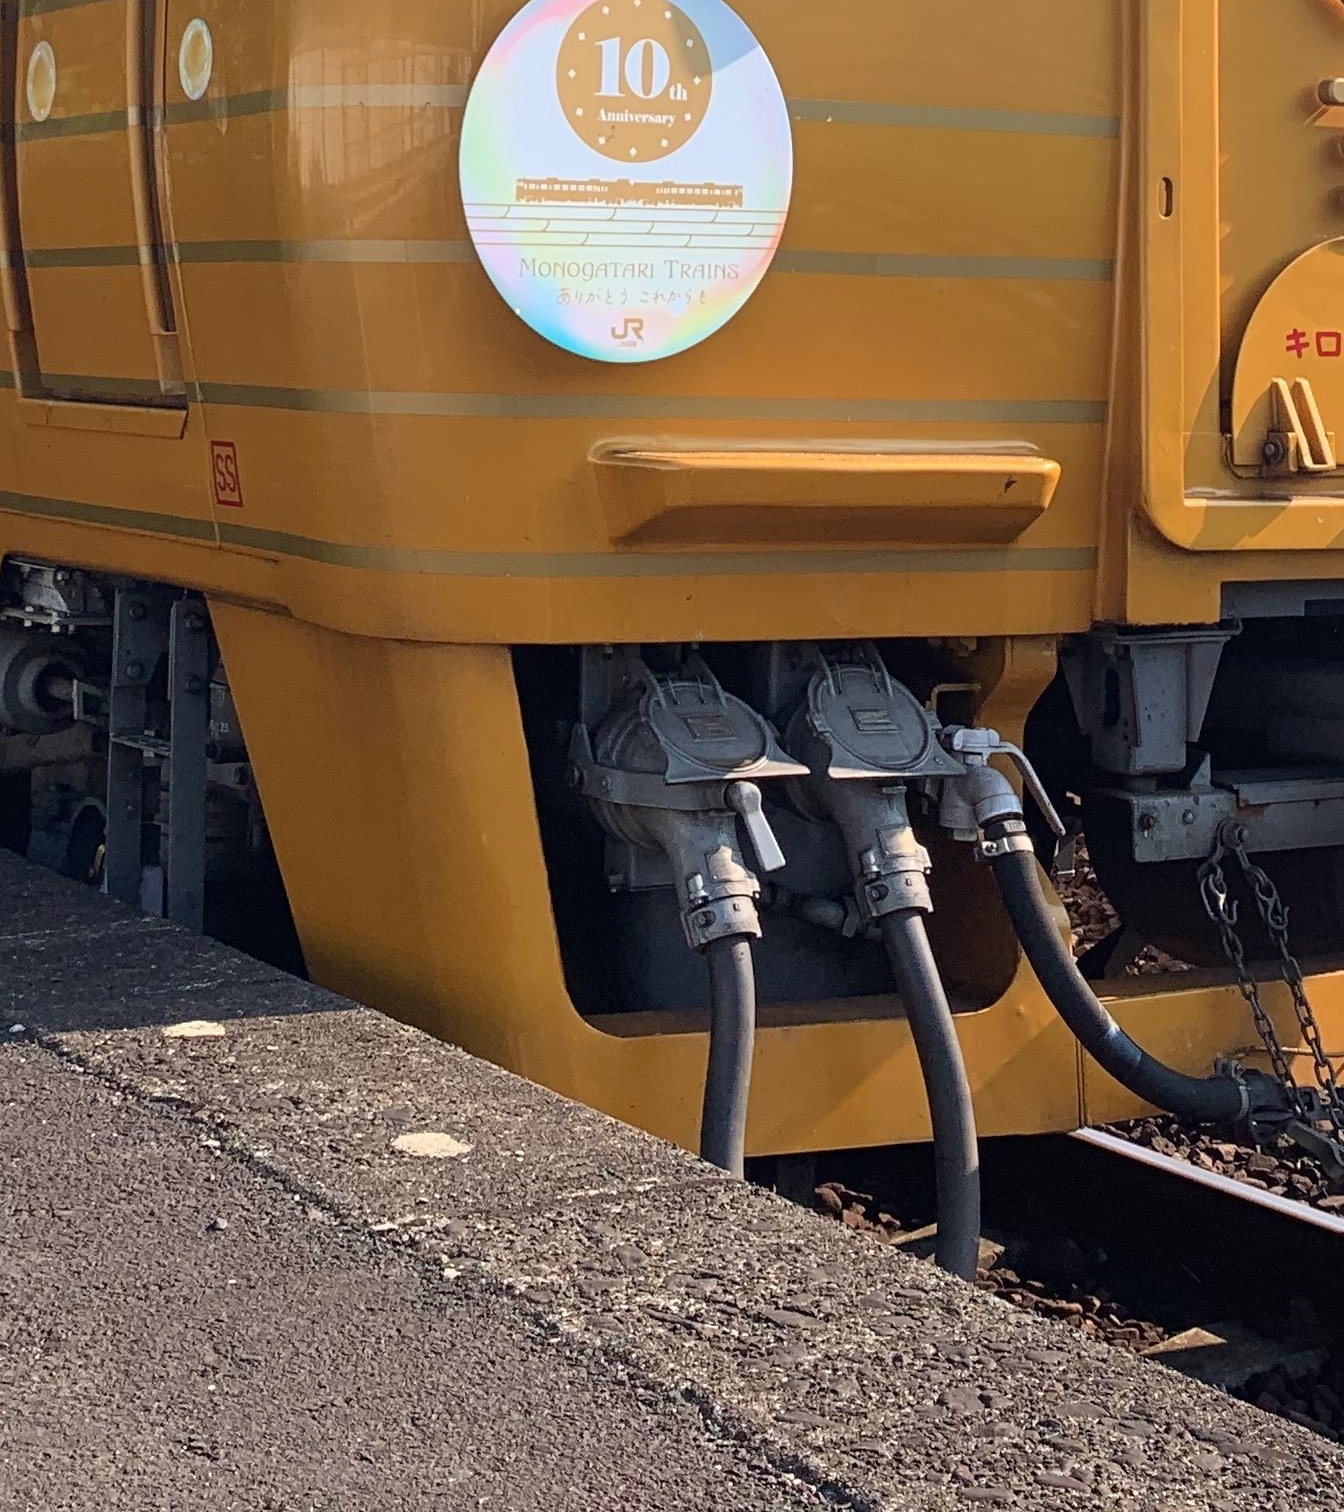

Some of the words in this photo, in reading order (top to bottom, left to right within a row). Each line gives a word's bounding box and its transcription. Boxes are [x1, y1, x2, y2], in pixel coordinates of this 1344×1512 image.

[597, 107, 675, 128] Anniversary
[517, 257, 655, 282] MONOGATARI
[663, 259, 740, 281] TRAINS
[556, 288, 628, 305] ありがとう
[639, 289, 707, 306] これからも
[610, 317, 644, 340] JR
[215, 452, 236, 493] SS
